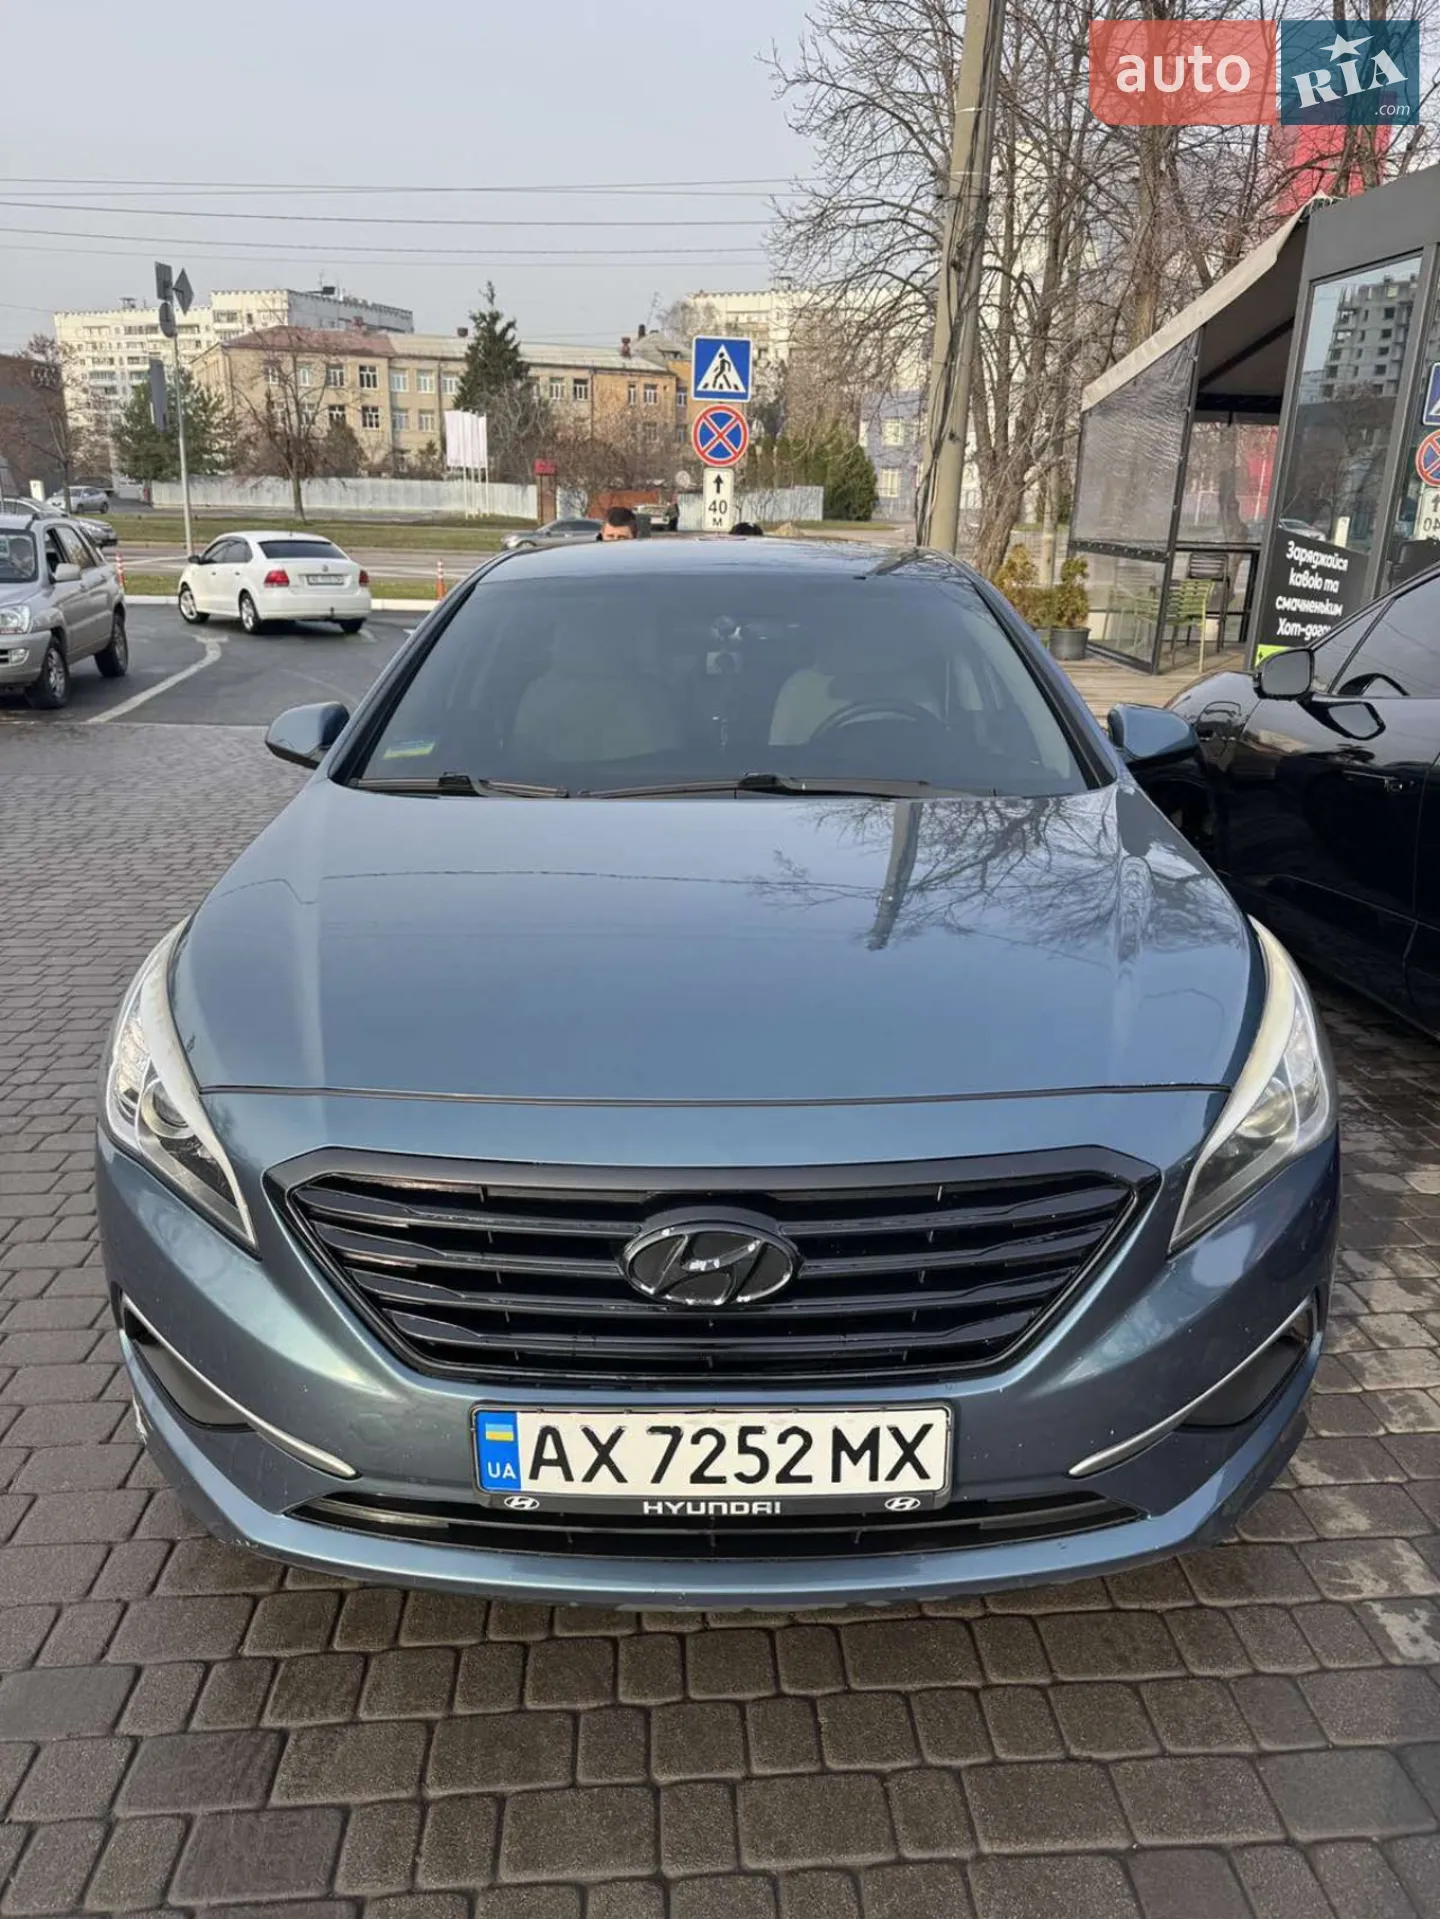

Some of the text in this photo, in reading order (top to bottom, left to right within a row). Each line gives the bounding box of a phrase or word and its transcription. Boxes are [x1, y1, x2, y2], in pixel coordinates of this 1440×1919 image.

[708, 499, 728, 514] 40
[1288, 567, 1340, 593] кавою та
[488, 1423, 934, 1485] UA AX 7252 MX
[643, 1501, 781, 1515] HYUNDAI
